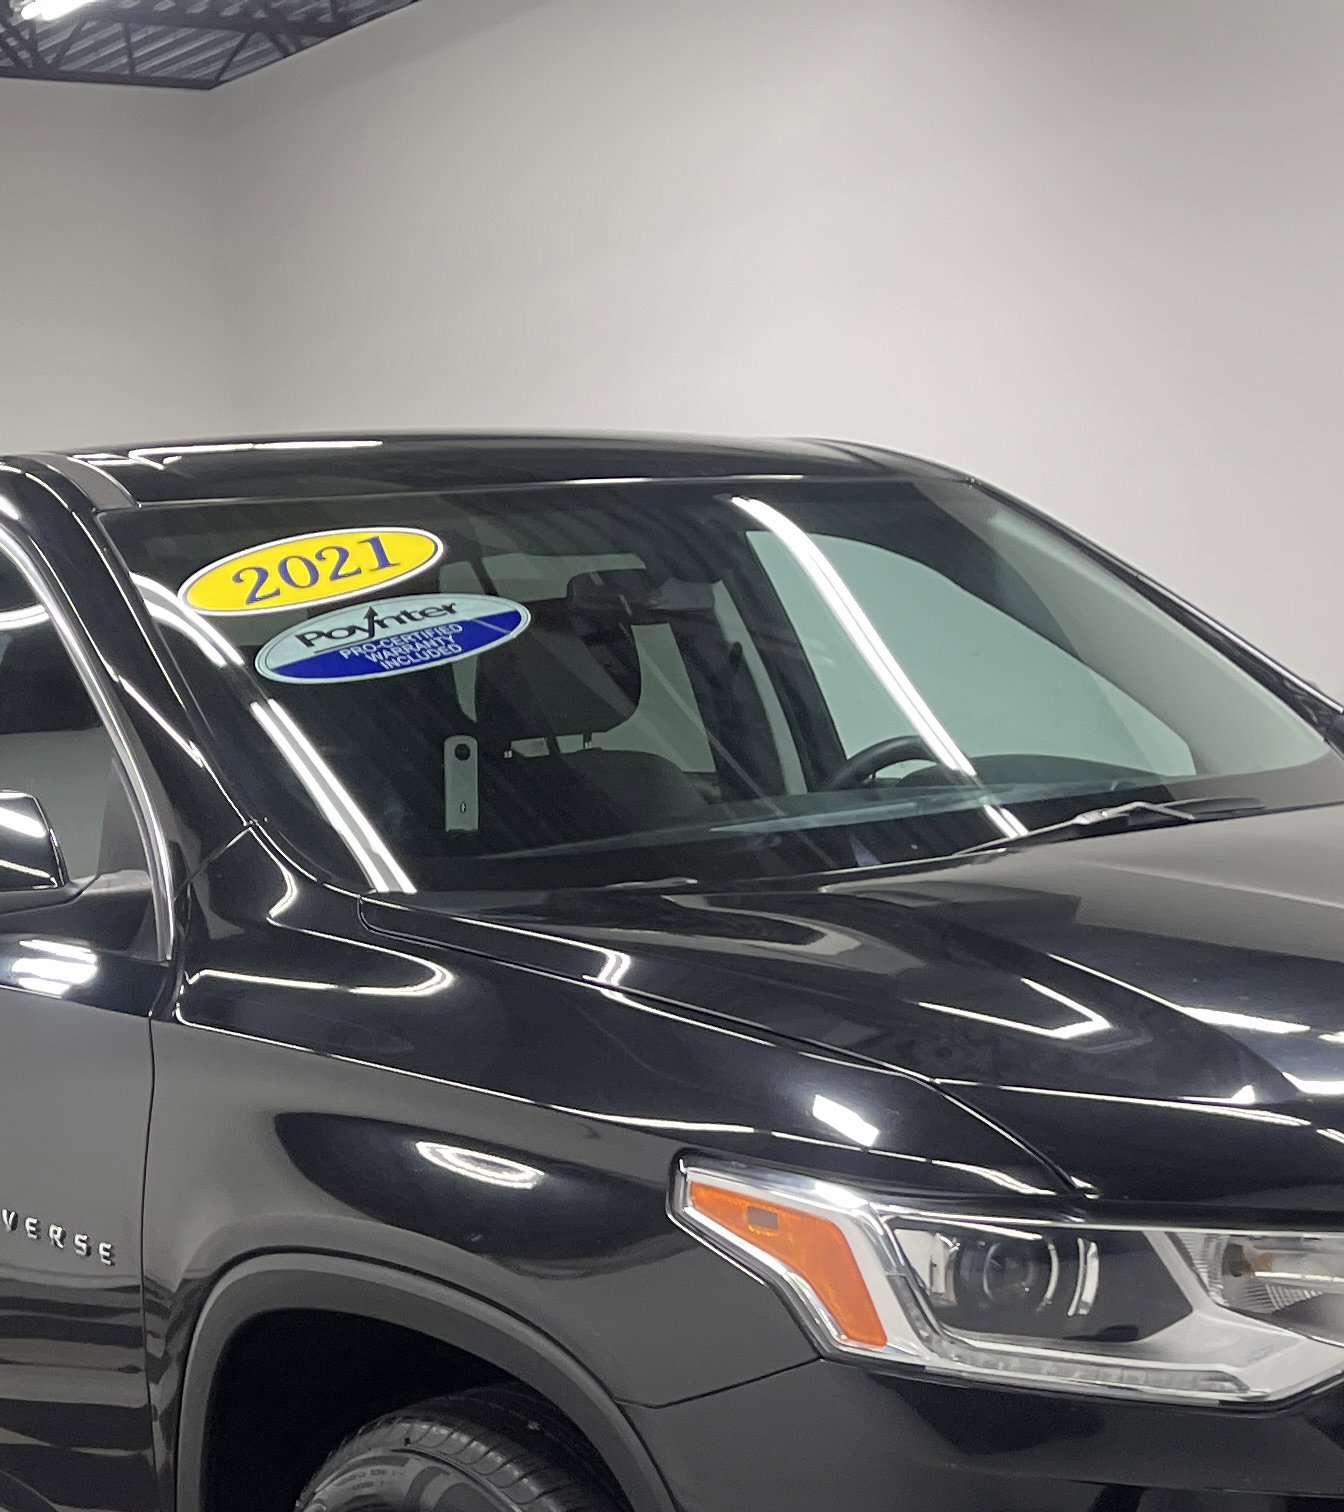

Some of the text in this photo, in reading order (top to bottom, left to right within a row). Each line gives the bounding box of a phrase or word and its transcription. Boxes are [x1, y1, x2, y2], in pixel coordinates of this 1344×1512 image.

[232, 536, 401, 604] 2021
[295, 607, 458, 647] Poynter
[339, 623, 463, 660] PRO-CERTIFIED
[364, 634, 457, 663] WARRANTY
[380, 644, 463, 671] INCLUDED
